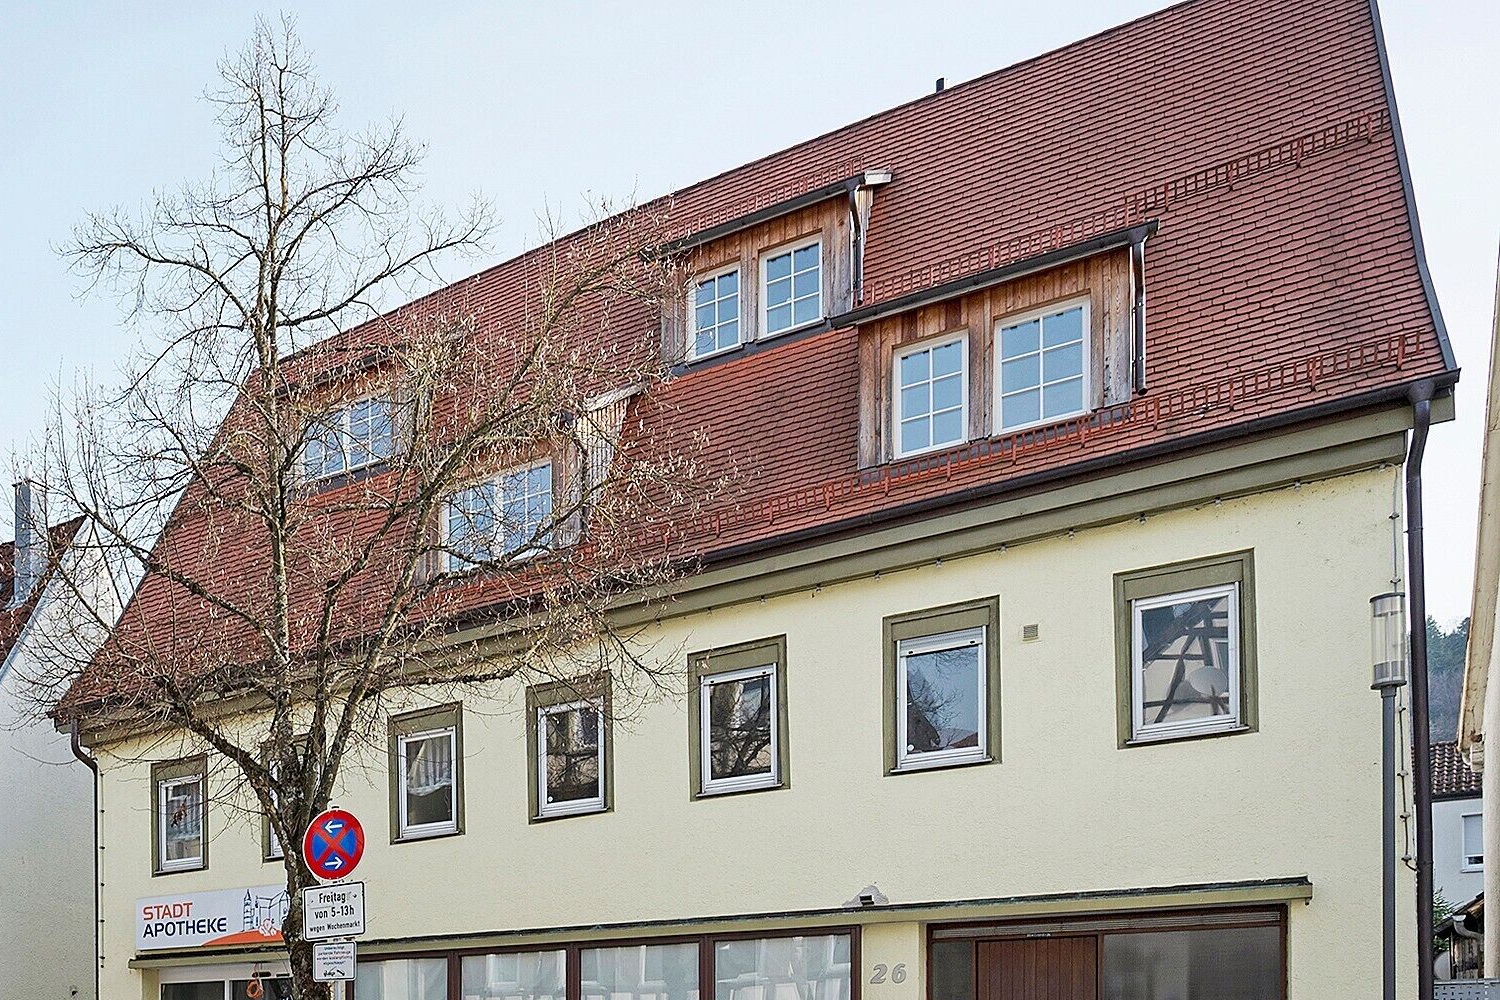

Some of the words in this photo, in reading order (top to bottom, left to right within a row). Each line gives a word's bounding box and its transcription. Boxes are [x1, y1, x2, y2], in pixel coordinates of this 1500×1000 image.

[319, 891, 346, 904] Freitag
[142, 902, 193, 921] STADT
[314, 910, 328, 919] von
[331, 904, 355, 918] 5-13h
[142, 917, 227, 938] APOTHEKE
[870, 963, 907, 984] 26
